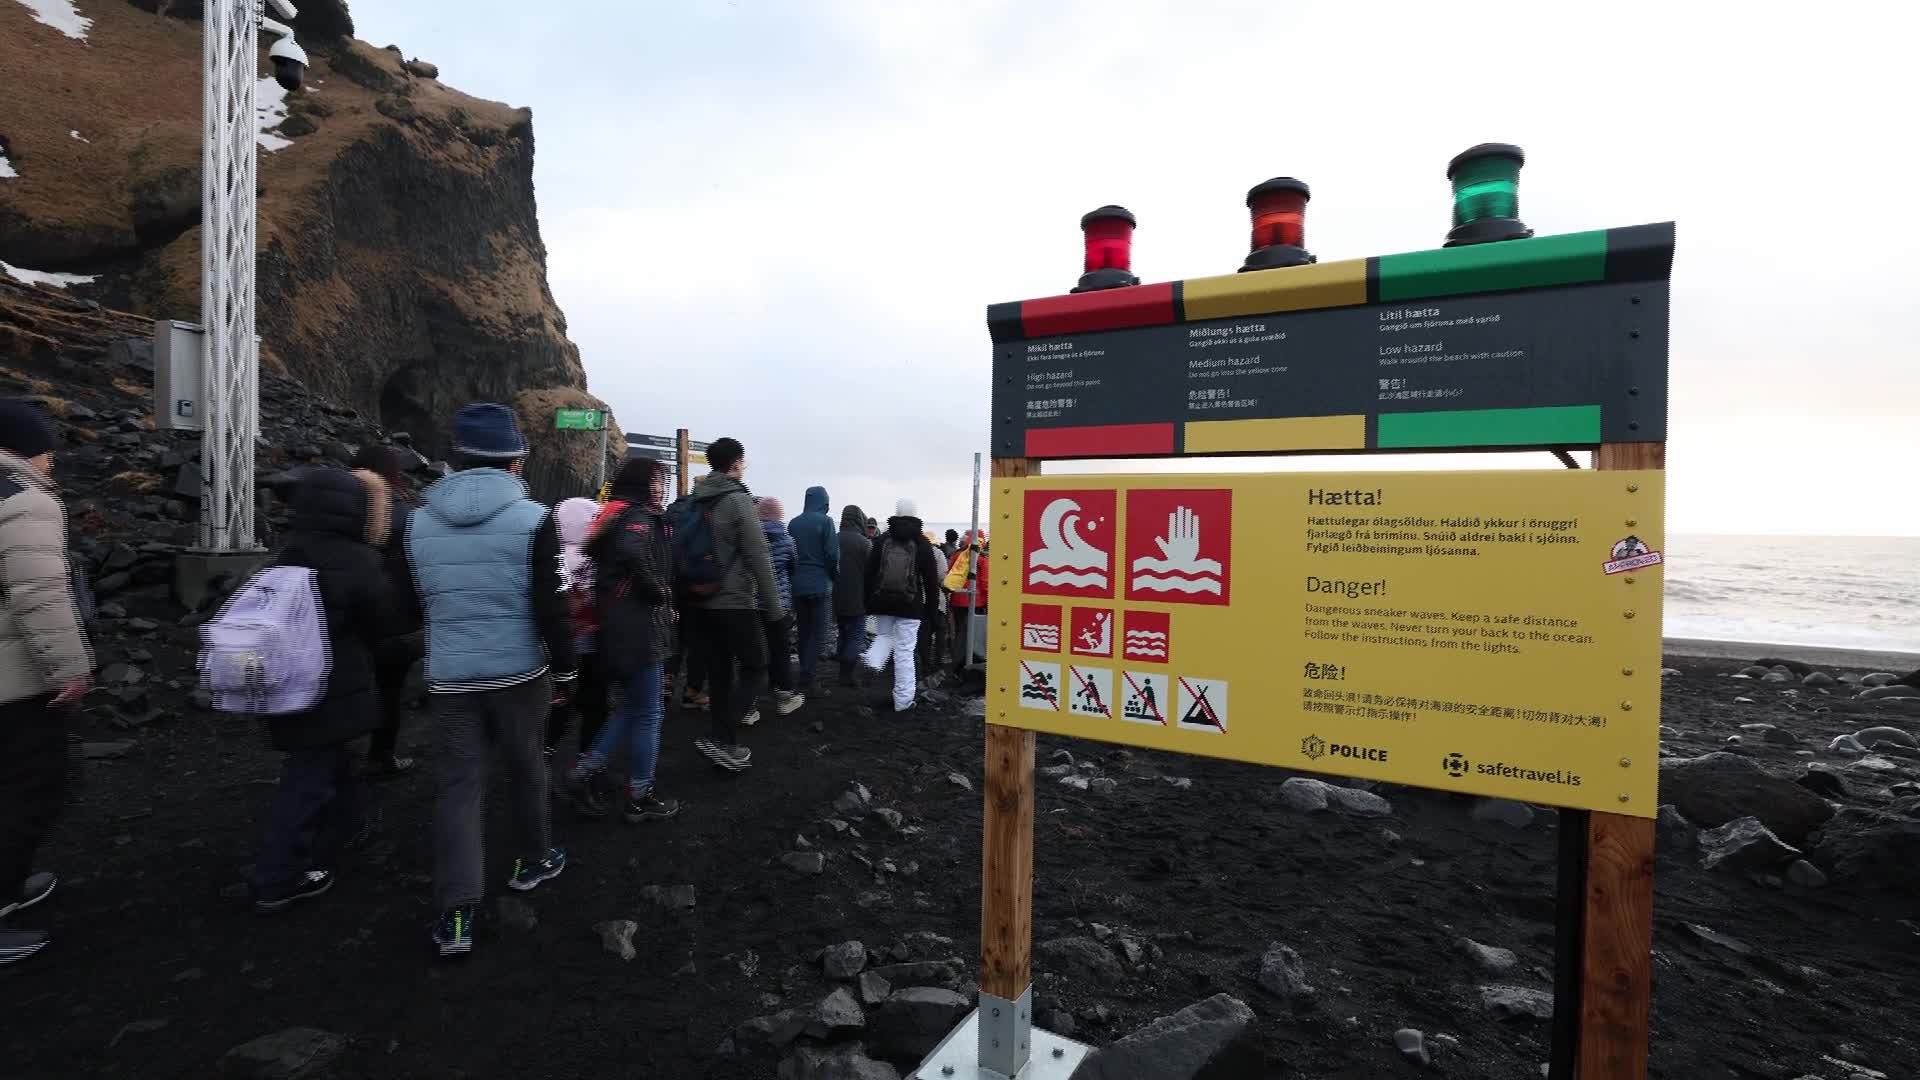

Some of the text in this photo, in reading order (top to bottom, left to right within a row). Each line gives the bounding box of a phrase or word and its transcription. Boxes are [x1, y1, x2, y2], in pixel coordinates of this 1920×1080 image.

[1379, 308, 1440, 321] Lítil hætta
[1379, 322, 1408, 332] Gangið
[1424, 320, 1454, 330] fjöruna
[1456, 316, 1474, 325] með
[1476, 314, 1501, 324] varúð
[1189, 324, 1265, 338] Miðlungs hætta
[1027, 342, 1073, 353] Mikil hætta
[1189, 338, 1213, 348] Gangið
[1214, 337, 1228, 345] ekki
[1244, 335, 1259, 344] gula
[1261, 332, 1286, 342] svæðið
[1379, 341, 1443, 355] Low hazard
[1189, 355, 1260, 369] Medium hazard
[1379, 349, 1523, 366] Walk around the beach with caution
[1027, 370, 1073, 383] High hazard
[1199, 370, 1210, 378] not
[1210, 371, 1219, 379] go
[1248, 367, 1270, 376] yellow
[1271, 366, 1288, 374] zone
[1053, 381, 1073, 390] beyond
[1085, 379, 1101, 388] point
[1378, 378, 1407, 390] 警告!
[1188, 389, 1230, 401] 危险警告!
[1308, 488, 1382, 506] Hætta!
[1307, 516, 1369, 528] Hættulegar
[1373, 516, 1437, 529] ólagsöldur.
[1441, 517, 1480, 528] Haldið
[1484, 517, 1519, 531] ykkur
[1529, 517, 1578, 531] öruggri
[1307, 529, 1352, 541] fjarlægð
[1355, 529, 1371, 540] frá
[1373, 530, 1420, 541] briminu.
[1424, 530, 1457, 542] Snúið
[1460, 531, 1495, 543] aldrei
[1498, 531, 1526, 543] baki
[1536, 532, 1580, 546] sjóinn.
[1307, 542, 1480, 557] Fylgið leiðbeiningum ljósanna.
[1306, 576, 1386, 599] Danger!
[1305, 603, 1578, 628] Dangerous sneaker waves. Keep a safe distance
[1305, 616, 1595, 645] from the waves. Never turn your back to the ocean.
[1304, 629, 1521, 654] Follow the instructions from the lights.
[1303, 661, 1346, 681] 危险!
[1329, 743, 1388, 762] POLICE
[1477, 762, 1581, 787] safetravel.is
